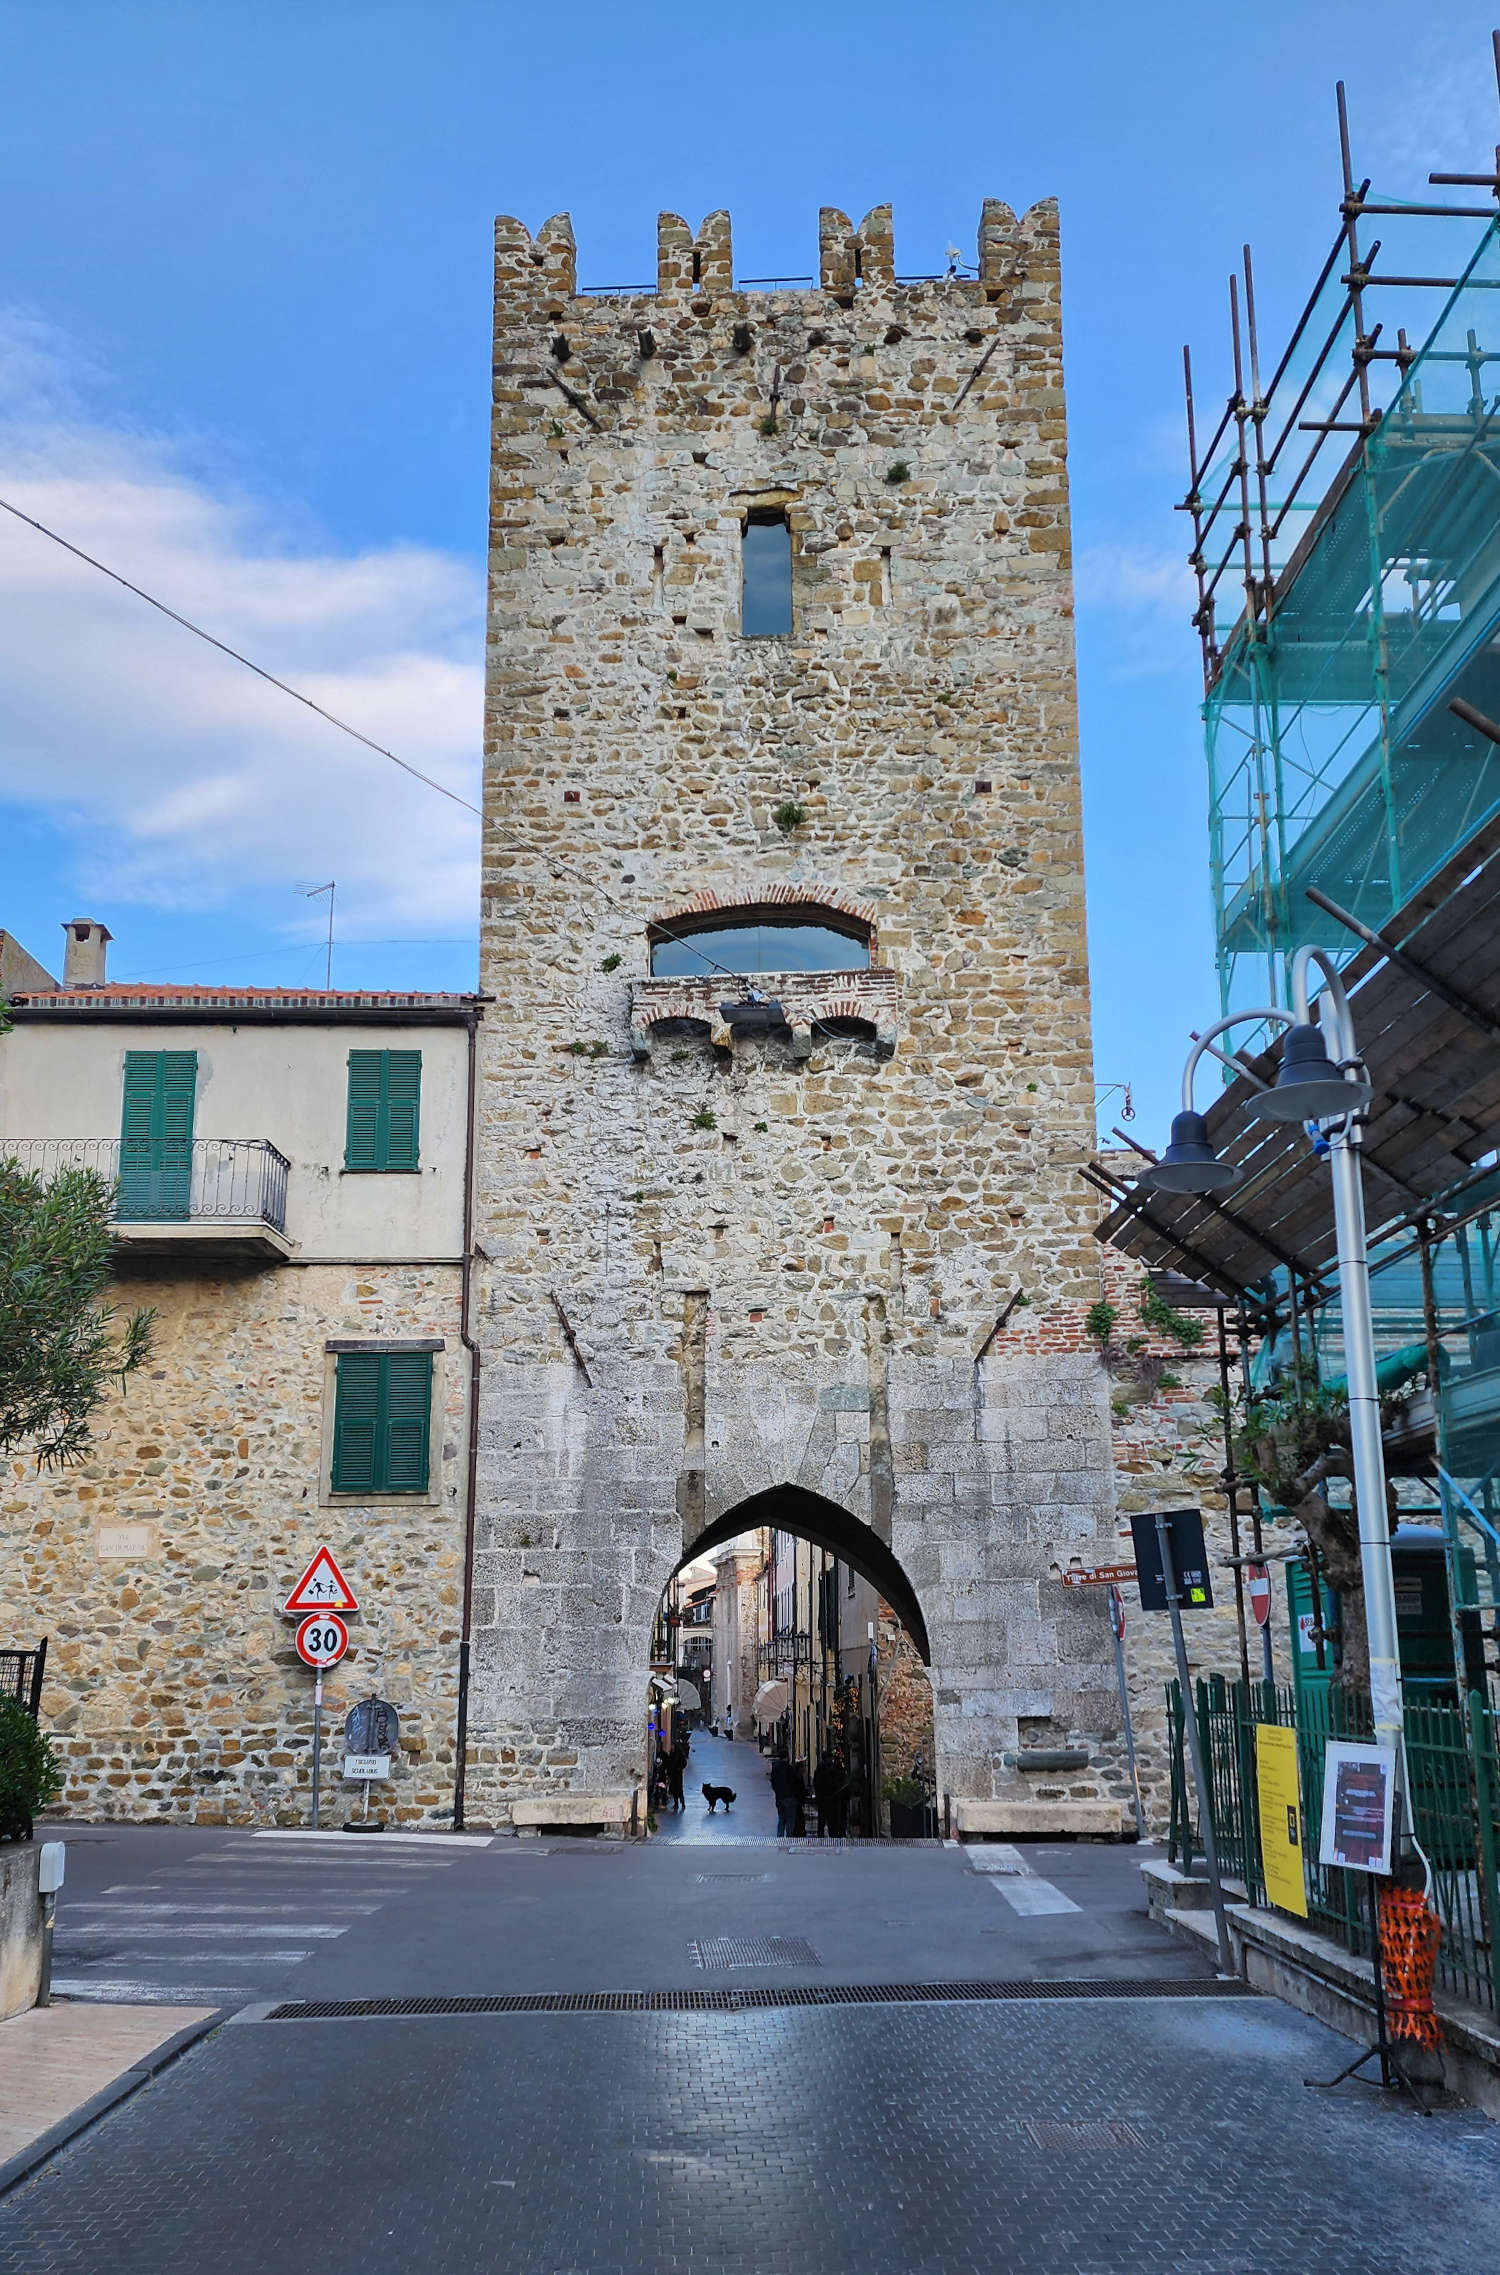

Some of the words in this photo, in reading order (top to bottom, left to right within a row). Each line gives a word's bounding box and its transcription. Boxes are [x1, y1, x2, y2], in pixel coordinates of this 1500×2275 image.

[1089, 1571, 1097, 1580] di
[1099, 1571, 1115, 1579] San
[308, 1627, 338, 1652] 30
